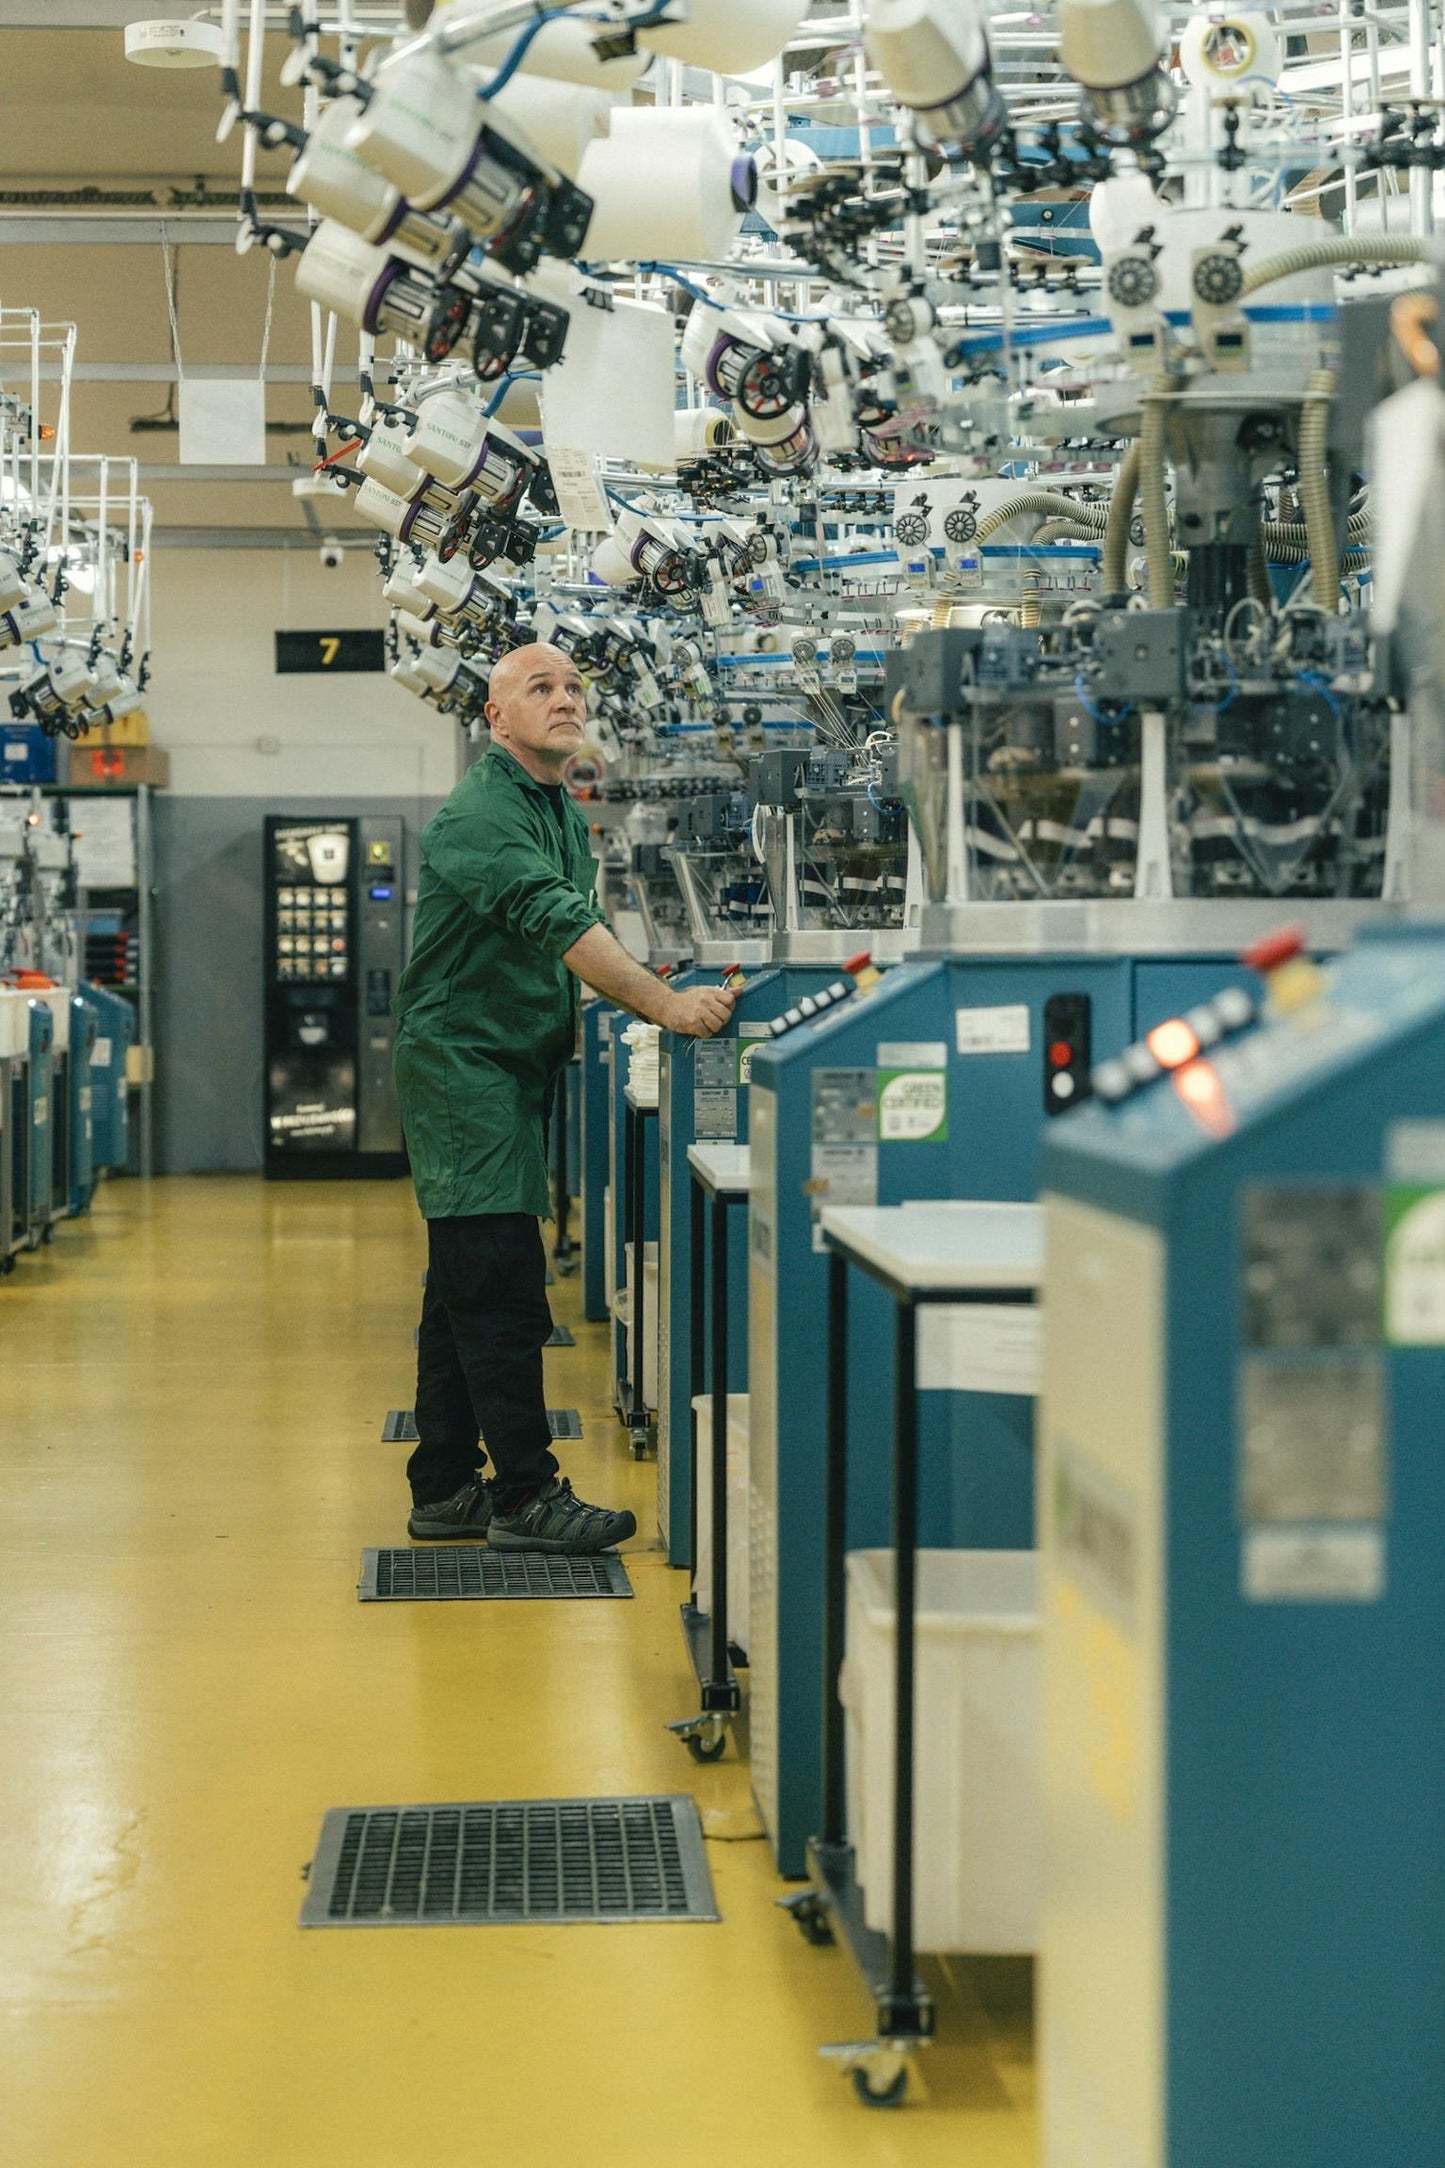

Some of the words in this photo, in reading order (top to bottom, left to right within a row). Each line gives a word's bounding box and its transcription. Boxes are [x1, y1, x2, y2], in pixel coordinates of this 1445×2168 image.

[427, 423, 459, 443] SANTONI
[364, 482, 391, 502] SANTONI
[319, 637, 340, 664] 7
[903, 1083, 941, 1093] GREEN
[883, 1098, 942, 1109] CERTIFIED
